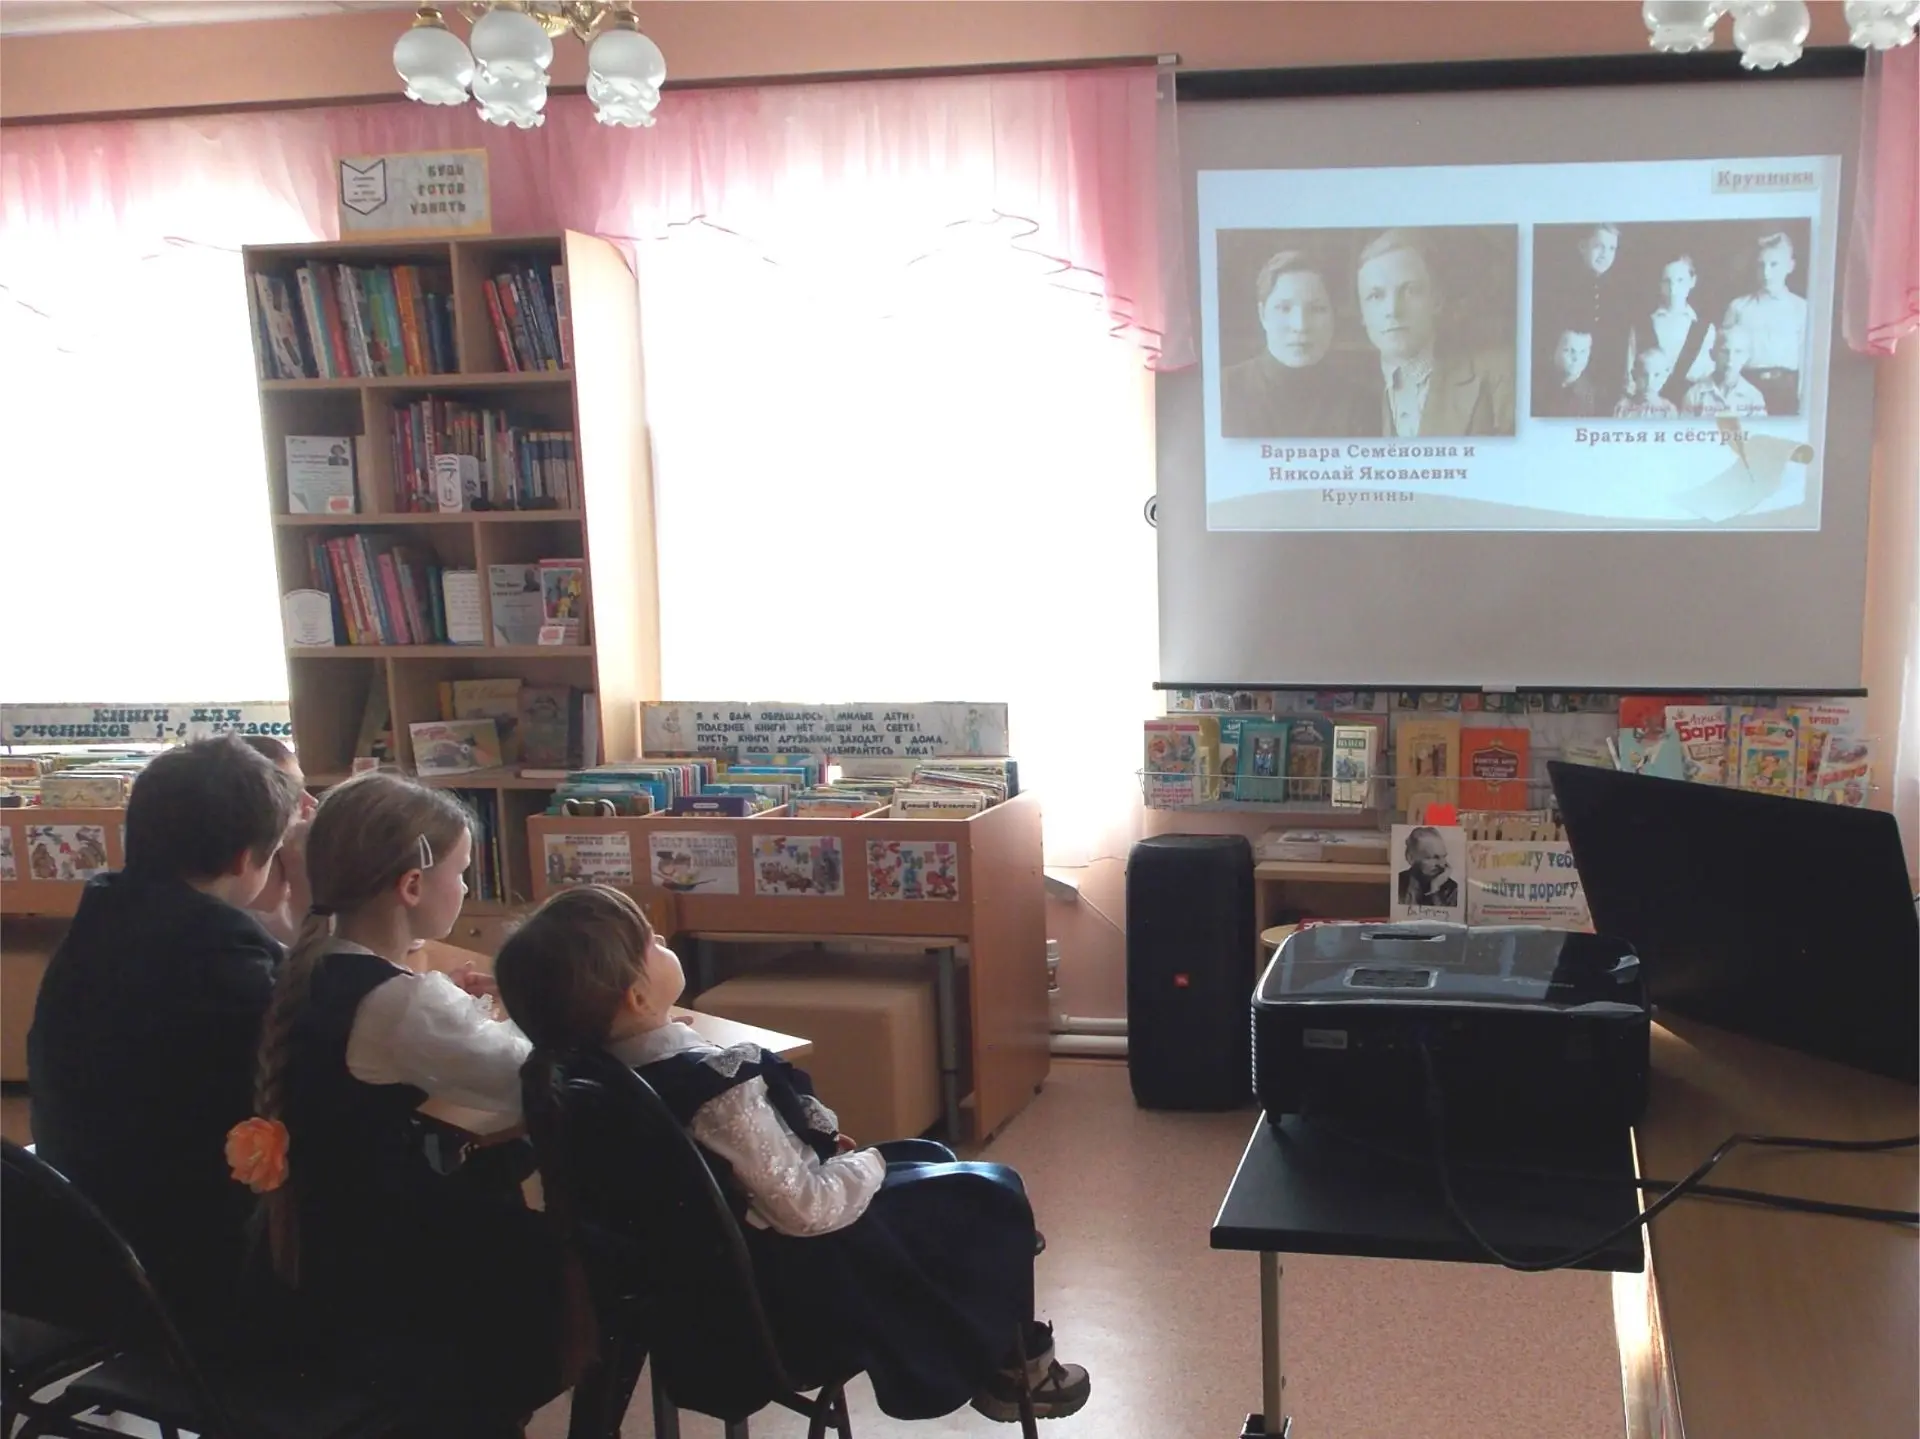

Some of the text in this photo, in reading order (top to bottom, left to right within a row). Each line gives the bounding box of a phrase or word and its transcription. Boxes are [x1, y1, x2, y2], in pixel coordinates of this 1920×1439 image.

[418, 183, 466, 196] ГОТОВ
[1575, 428, 1749, 446] Братья и сёстры
[1260, 443, 1475, 462] Варвара Семёновна и
[1269, 465, 1468, 480] Николай Яковлевич
[1321, 489, 1415, 505] Крупины
[93, 709, 242, 722] КНИГИ ДЛЯ
[729, 712, 752, 720] ВАМ
[837, 712, 874, 720] МИЛЫЕ
[697, 723, 745, 732] ПОЛЕЗНЕЕ
[754, 723, 786, 732] КНИГИ
[797, 723, 813, 732] НЕТ
[862, 724, 876, 732] НА
[697, 734, 728, 744] ПУСТЬ
[738, 734, 769, 743] КНИГИ
[1547, 850, 1575, 867] теб
